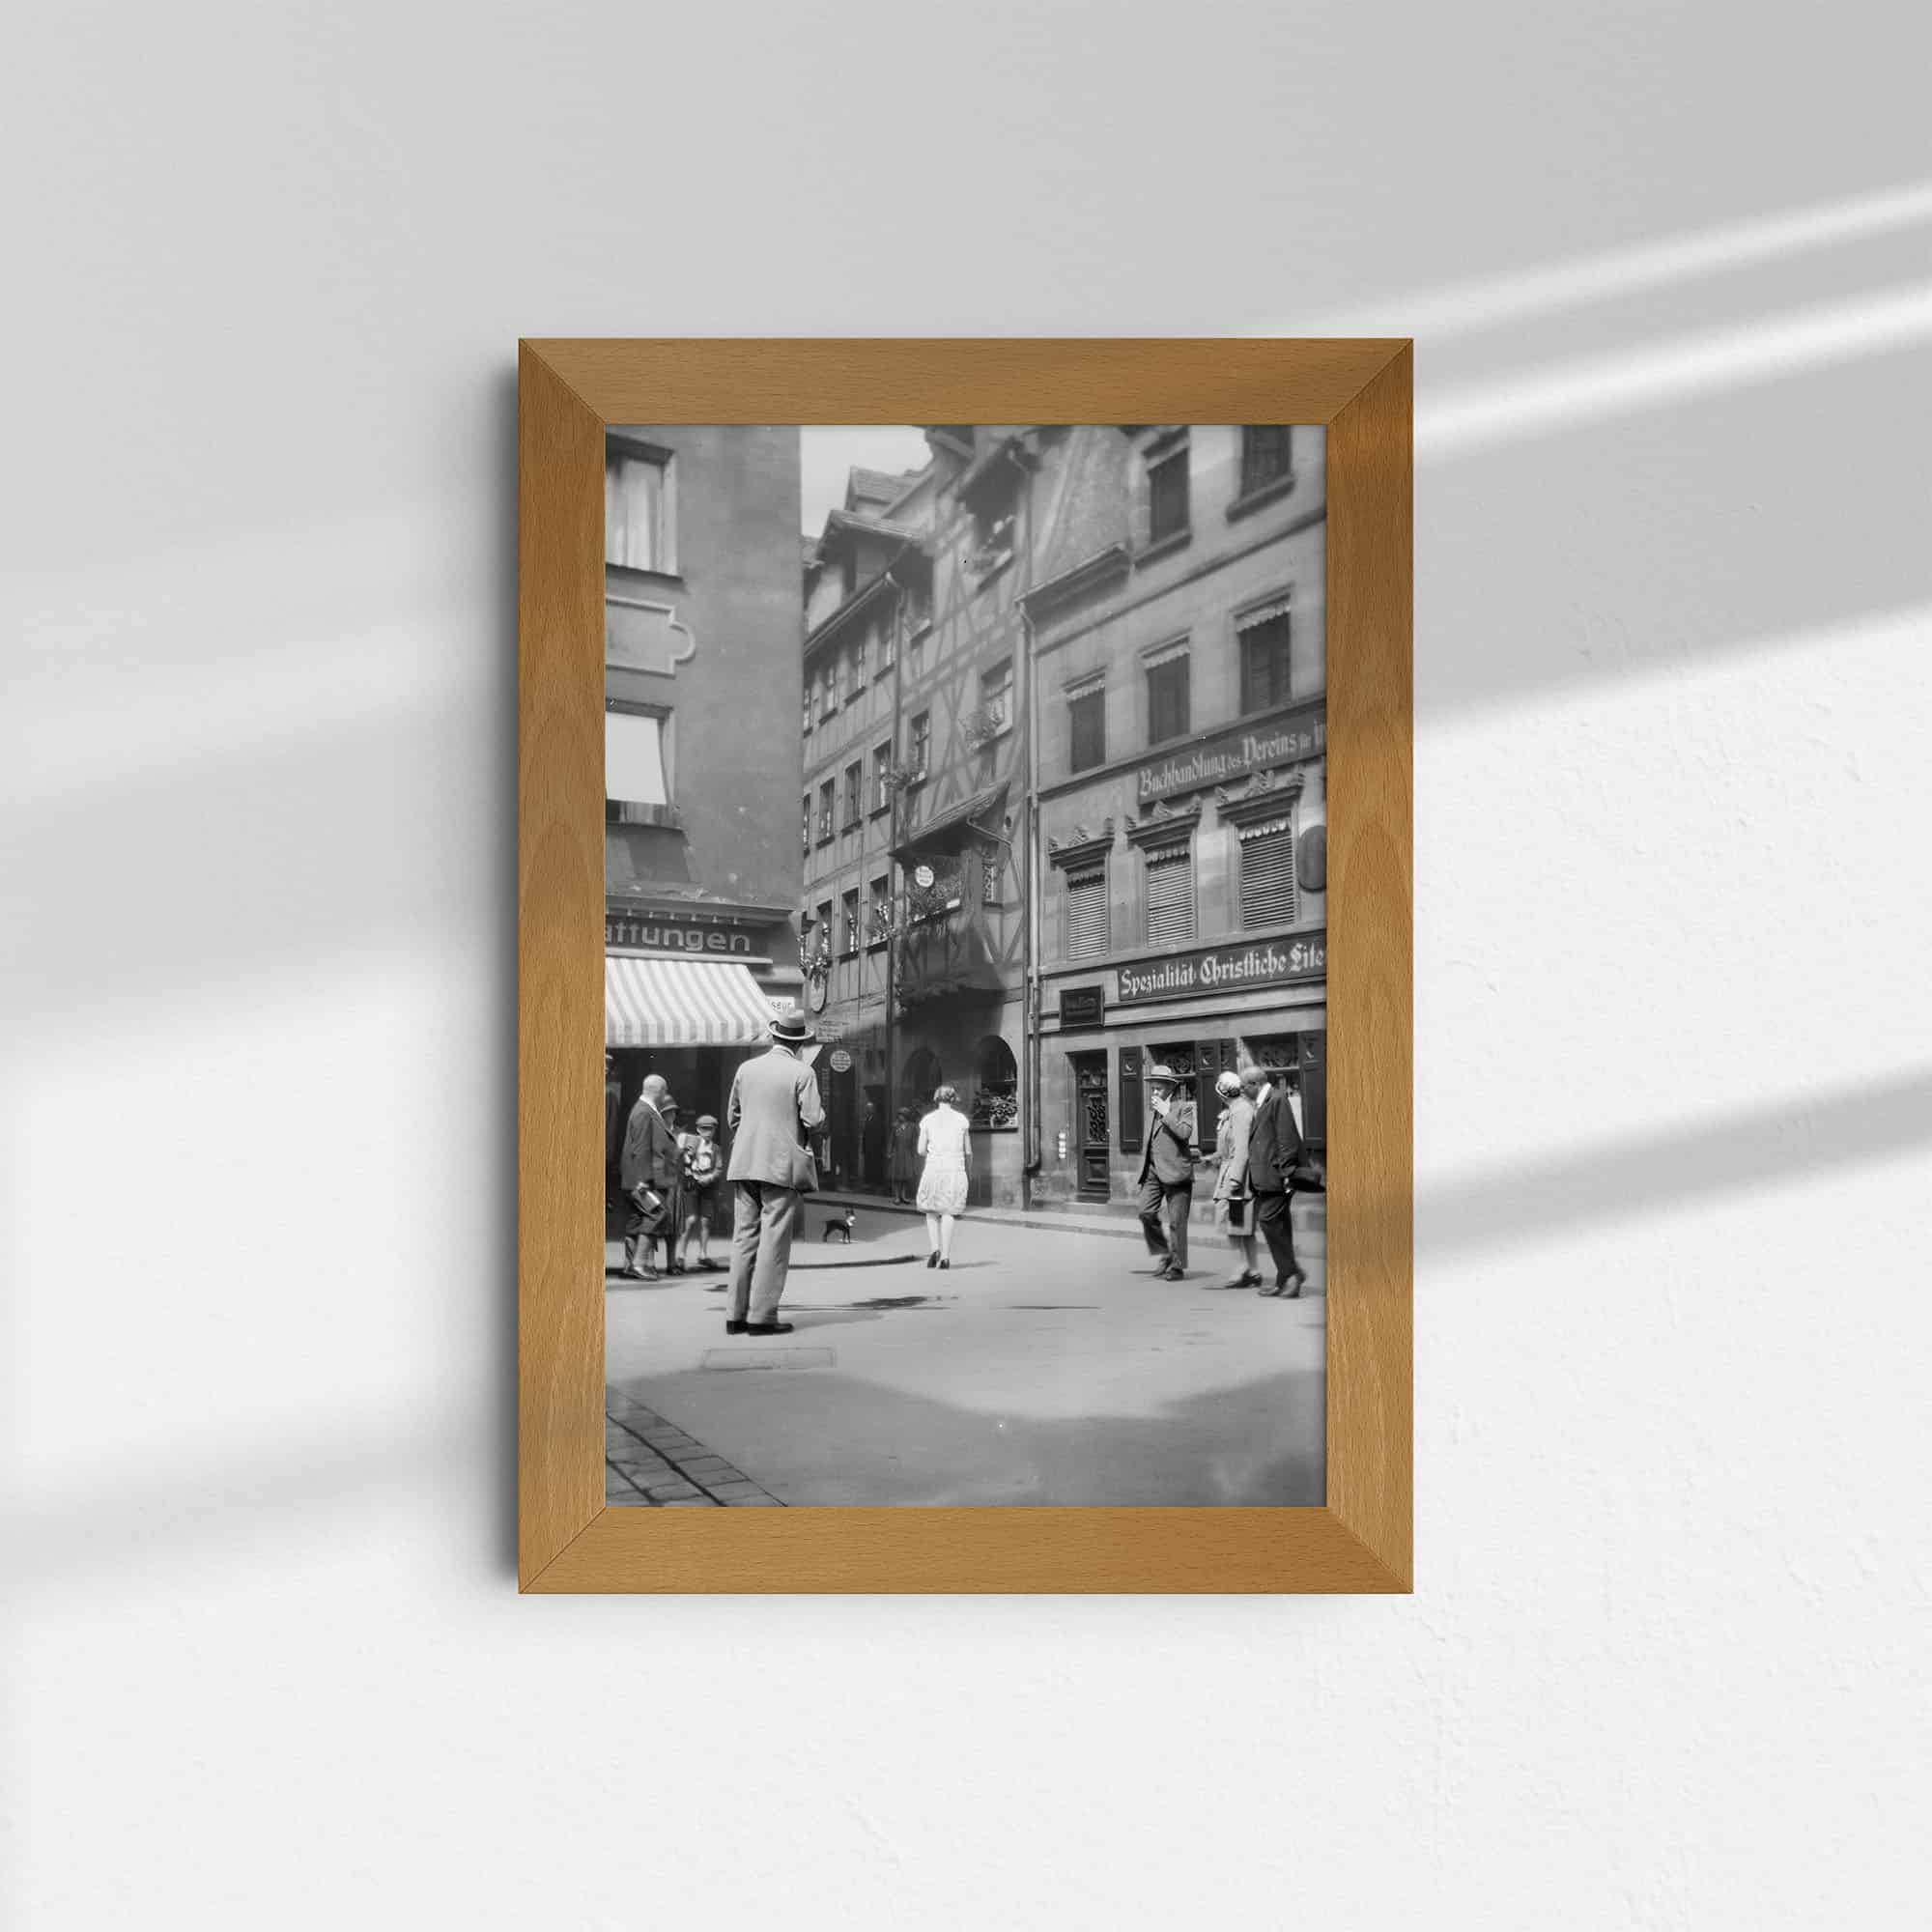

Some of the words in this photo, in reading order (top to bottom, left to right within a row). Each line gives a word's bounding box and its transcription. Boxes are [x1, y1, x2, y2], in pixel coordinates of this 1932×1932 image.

[1140, 750, 1226, 796] Buchhandlung
[1242, 731, 1296, 770] Vereins
[1200, 945, 1286, 984] Christliche
